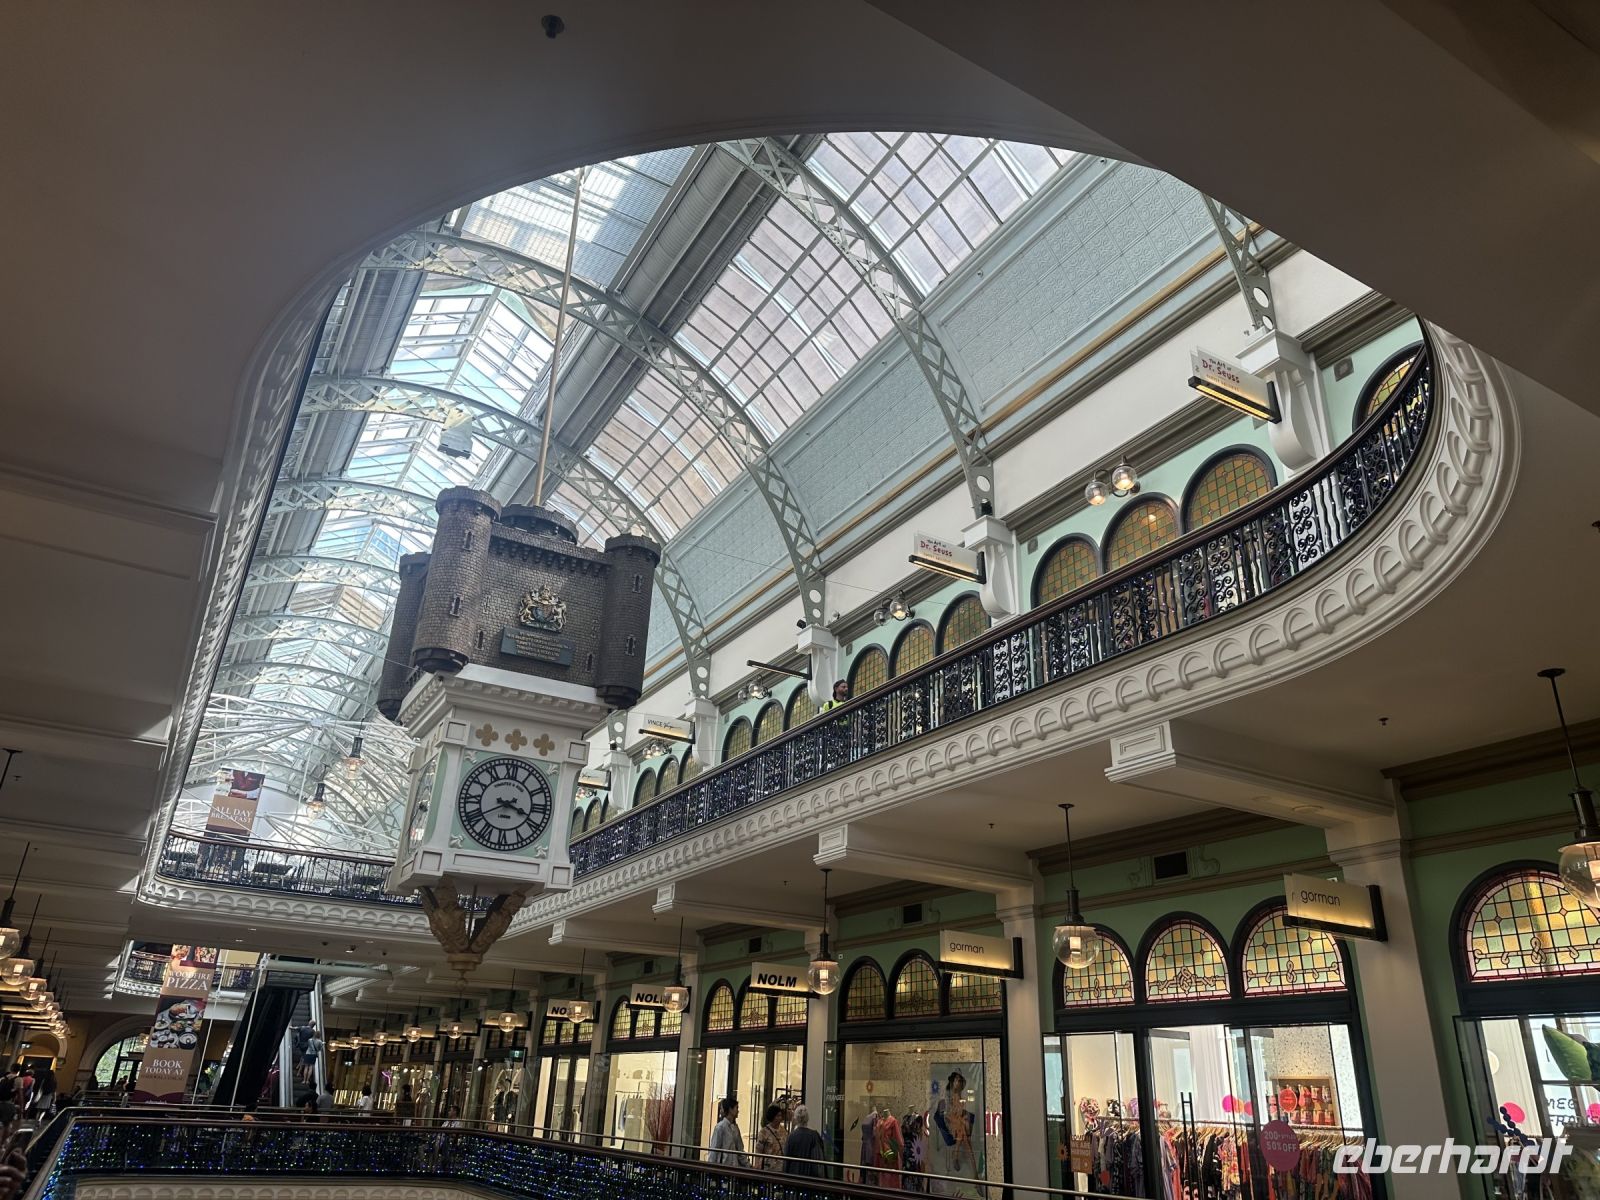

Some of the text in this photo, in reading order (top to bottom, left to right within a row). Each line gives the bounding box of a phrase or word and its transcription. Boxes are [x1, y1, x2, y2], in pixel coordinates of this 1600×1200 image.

[216, 806, 253, 818] ALL DAY
[1300, 890, 1341, 906] gorman
[949, 942, 985, 954] gorman
[166, 976, 208, 991] PIZZA
[757, 973, 797, 988] NOLM
[153, 1059, 183, 1069] BOOK
[145, 1066, 173, 1075] TODAY
[1283, 1143, 1297, 1152] OFF
